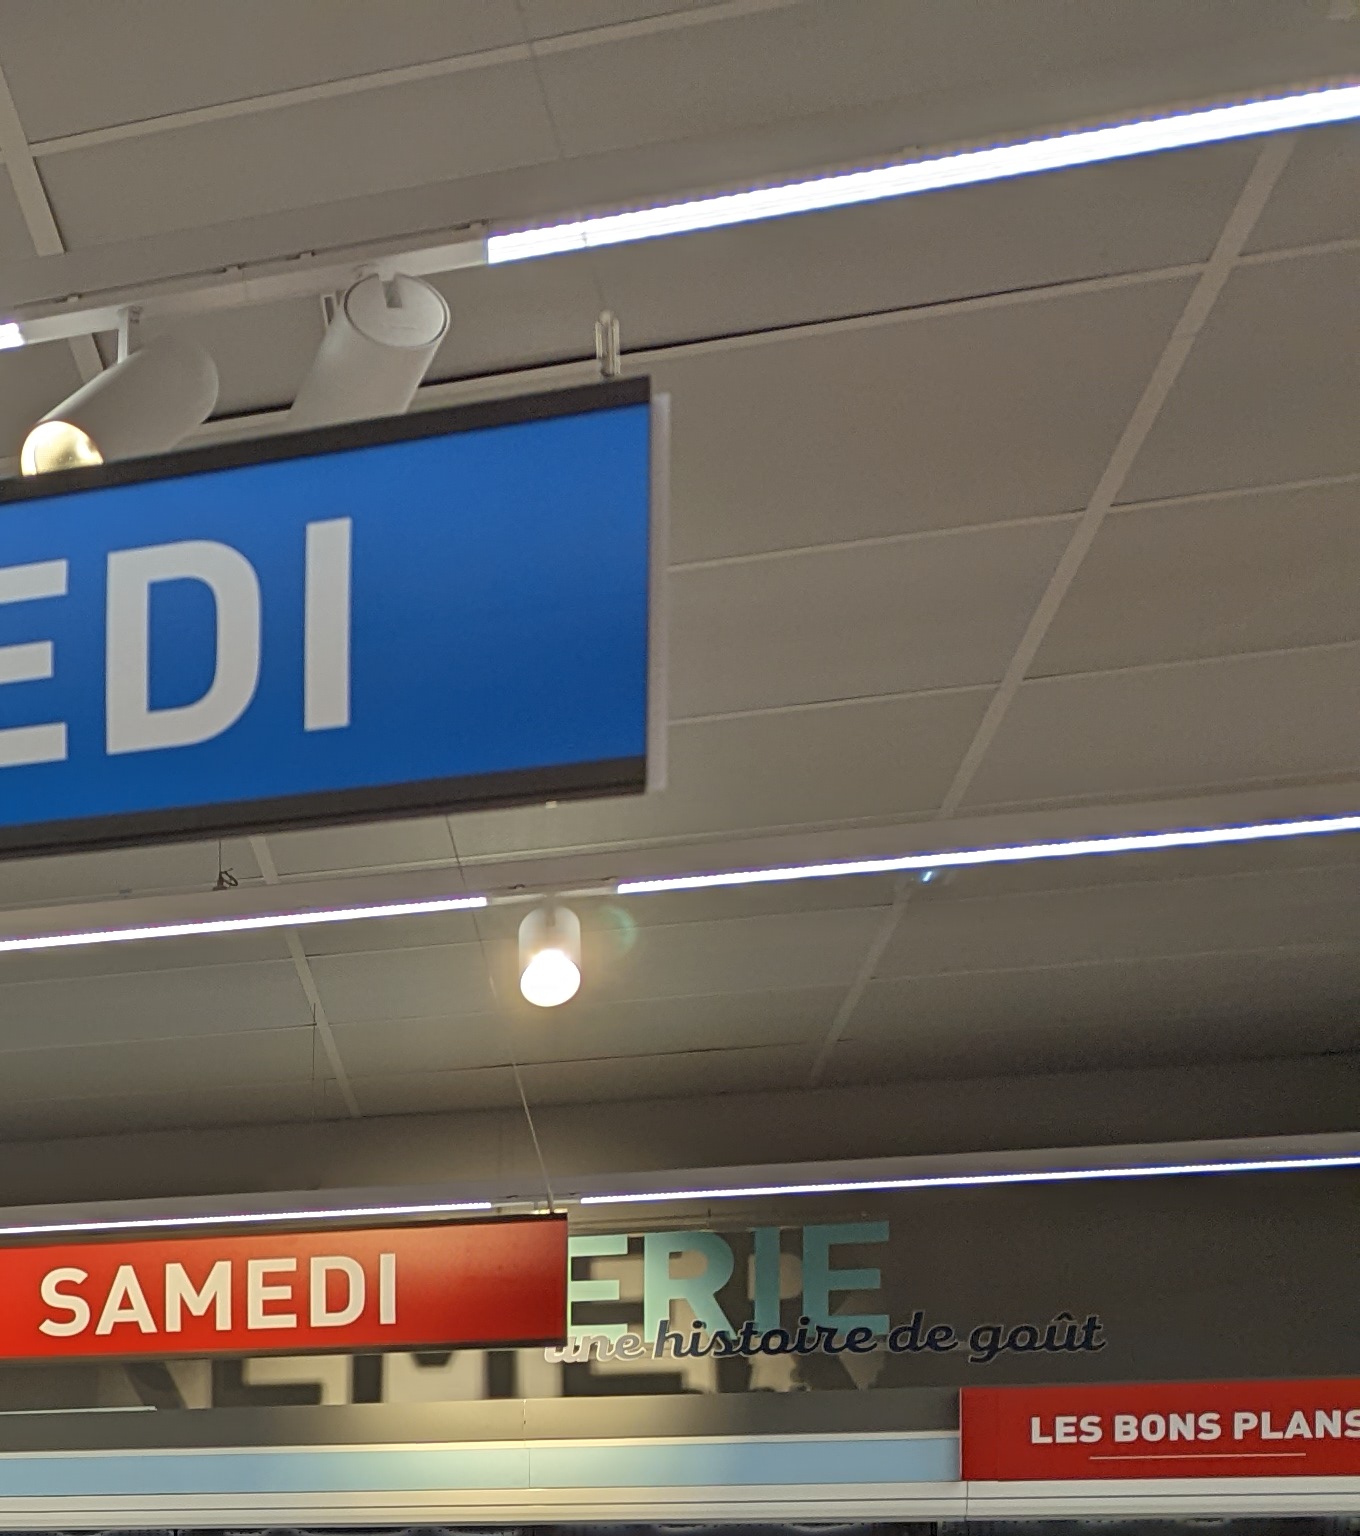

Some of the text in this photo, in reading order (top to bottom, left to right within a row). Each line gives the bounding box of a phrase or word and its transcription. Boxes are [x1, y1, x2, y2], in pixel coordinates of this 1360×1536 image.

[38, 1252, 397, 1338] SAMEDI
[568, 1221, 890, 1343] ERIE
[654, 1316, 882, 1359] histoire
[887, 1310, 964, 1353] de
[970, 1311, 1106, 1363] goût
[1031, 1409, 1360, 1445] LES BONS PLANS
